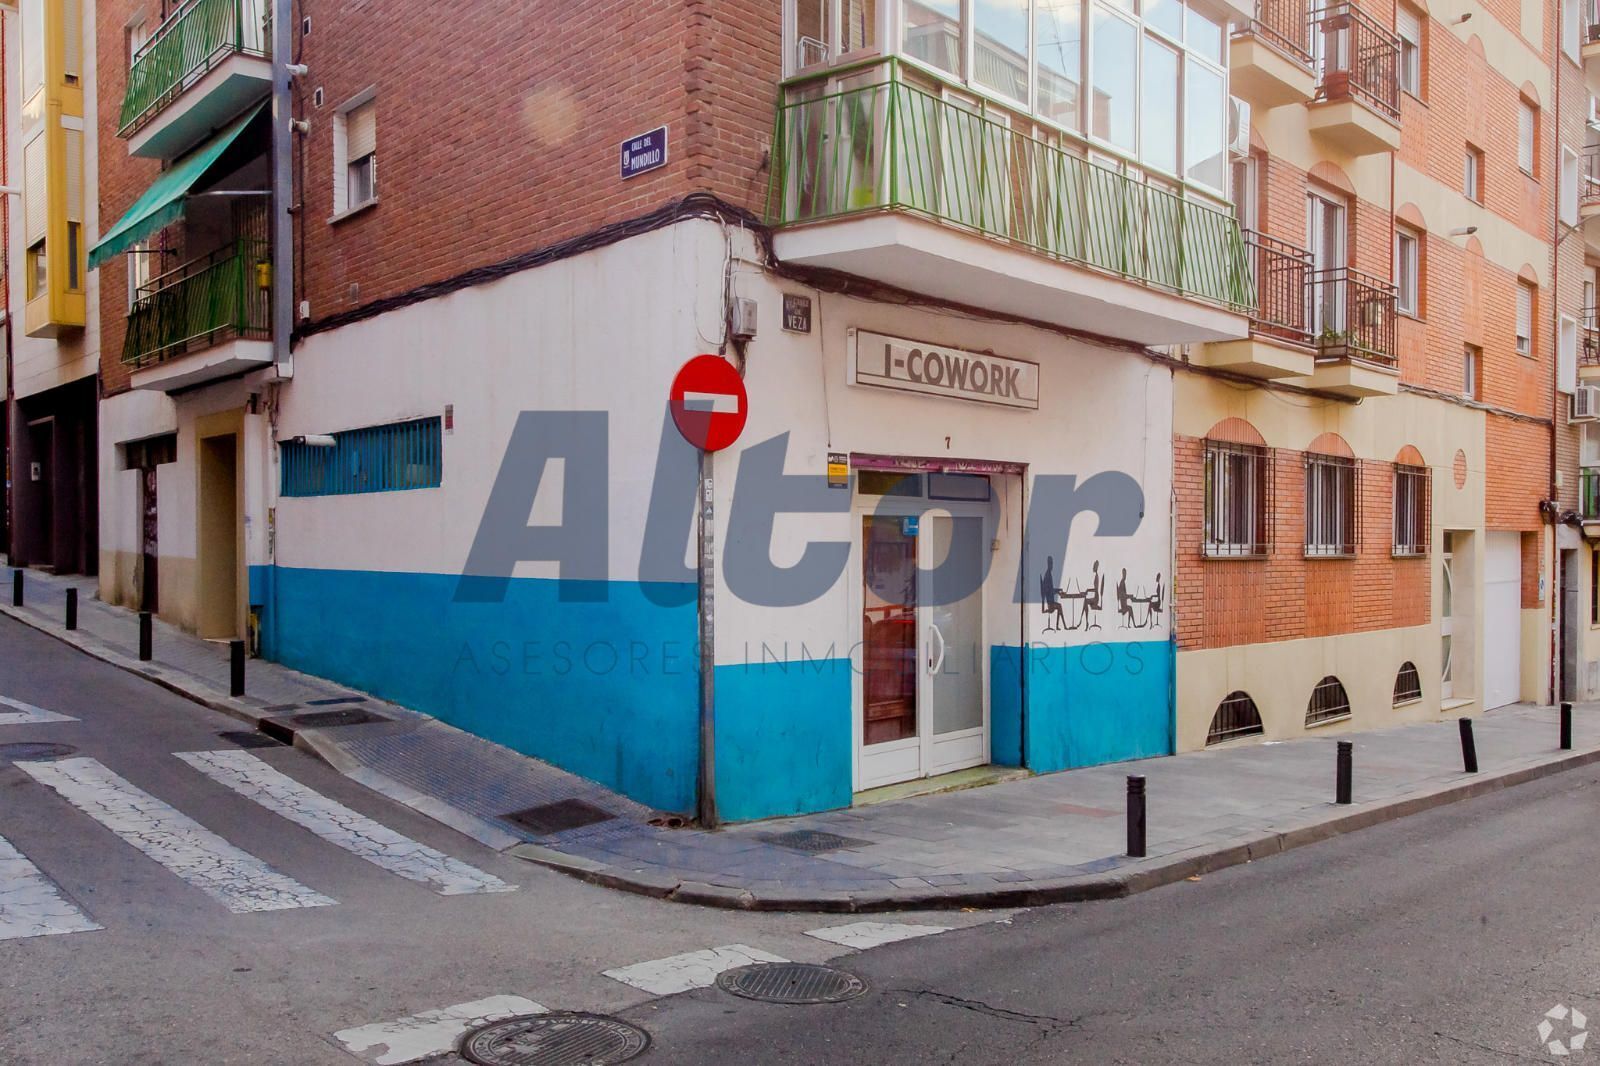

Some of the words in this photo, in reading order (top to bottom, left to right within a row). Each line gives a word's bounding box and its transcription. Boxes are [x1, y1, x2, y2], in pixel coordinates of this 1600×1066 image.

[631, 140, 642, 151] CALLE
[643, 137, 652, 147] DEL
[631, 149, 660, 170] MUNDILLO
[787, 314, 807, 331] VEZA
[884, 343, 1020, 399] I-COWORK
[944, 436, 951, 450] 7
